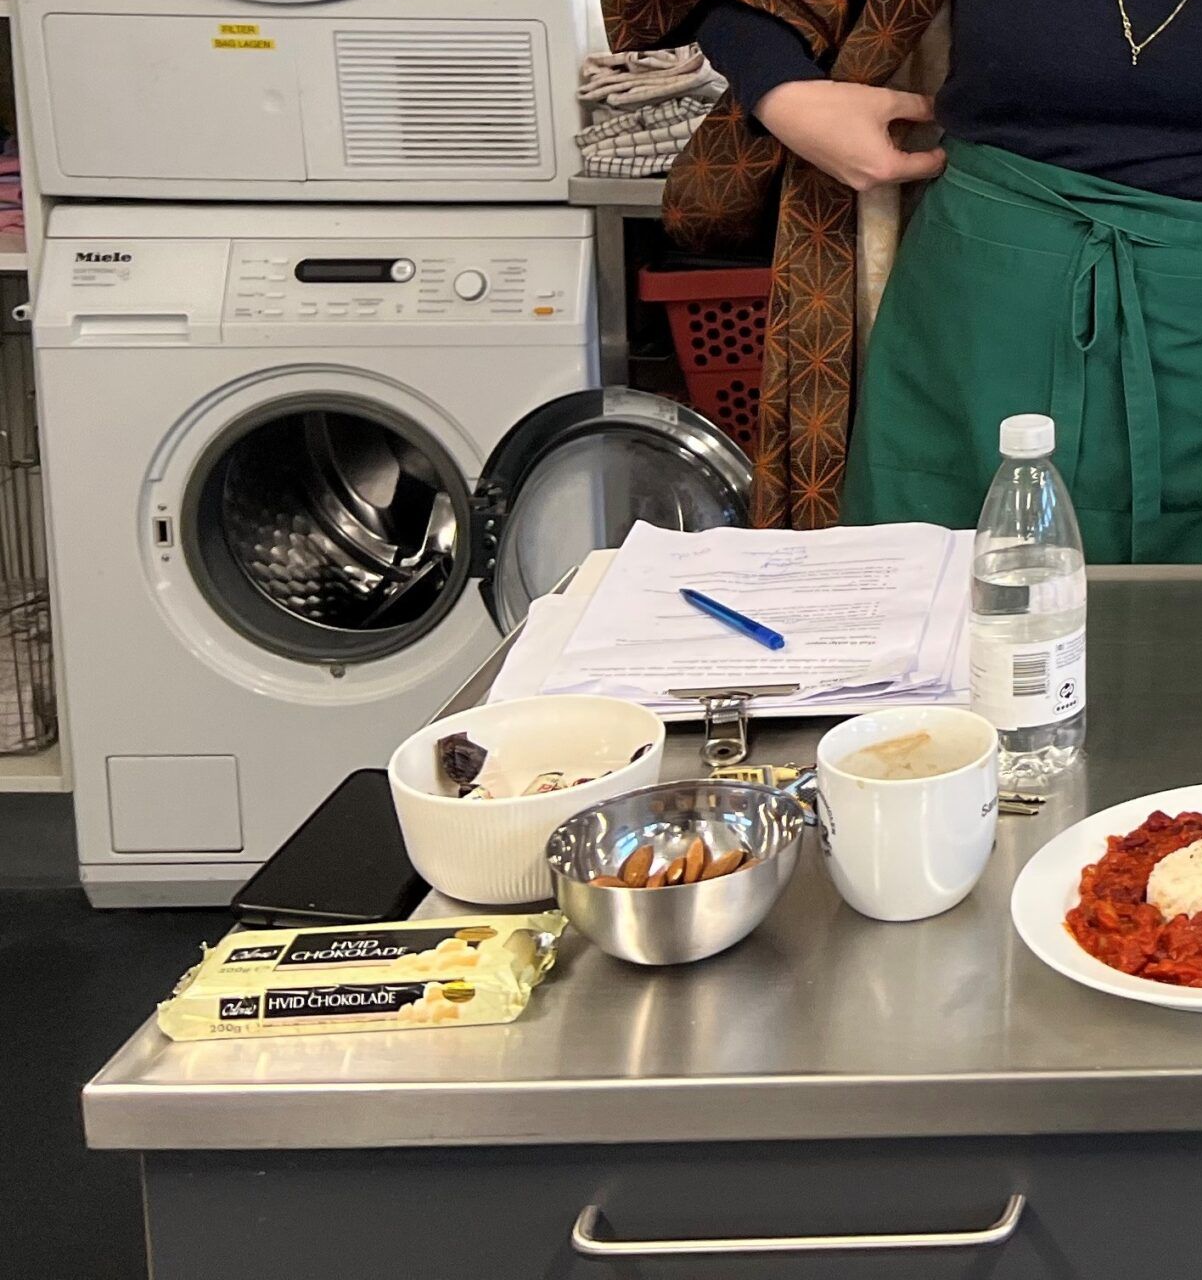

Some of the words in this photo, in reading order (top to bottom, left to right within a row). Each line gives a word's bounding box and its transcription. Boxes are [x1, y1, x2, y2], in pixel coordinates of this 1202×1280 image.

[75, 252, 132, 262] Miele
[331, 939, 379, 950] HVID
[291, 946, 408, 961] CHOKOLADE
[268, 995, 305, 1010] HVID
[307, 991, 397, 1007] CHOKOLADE
